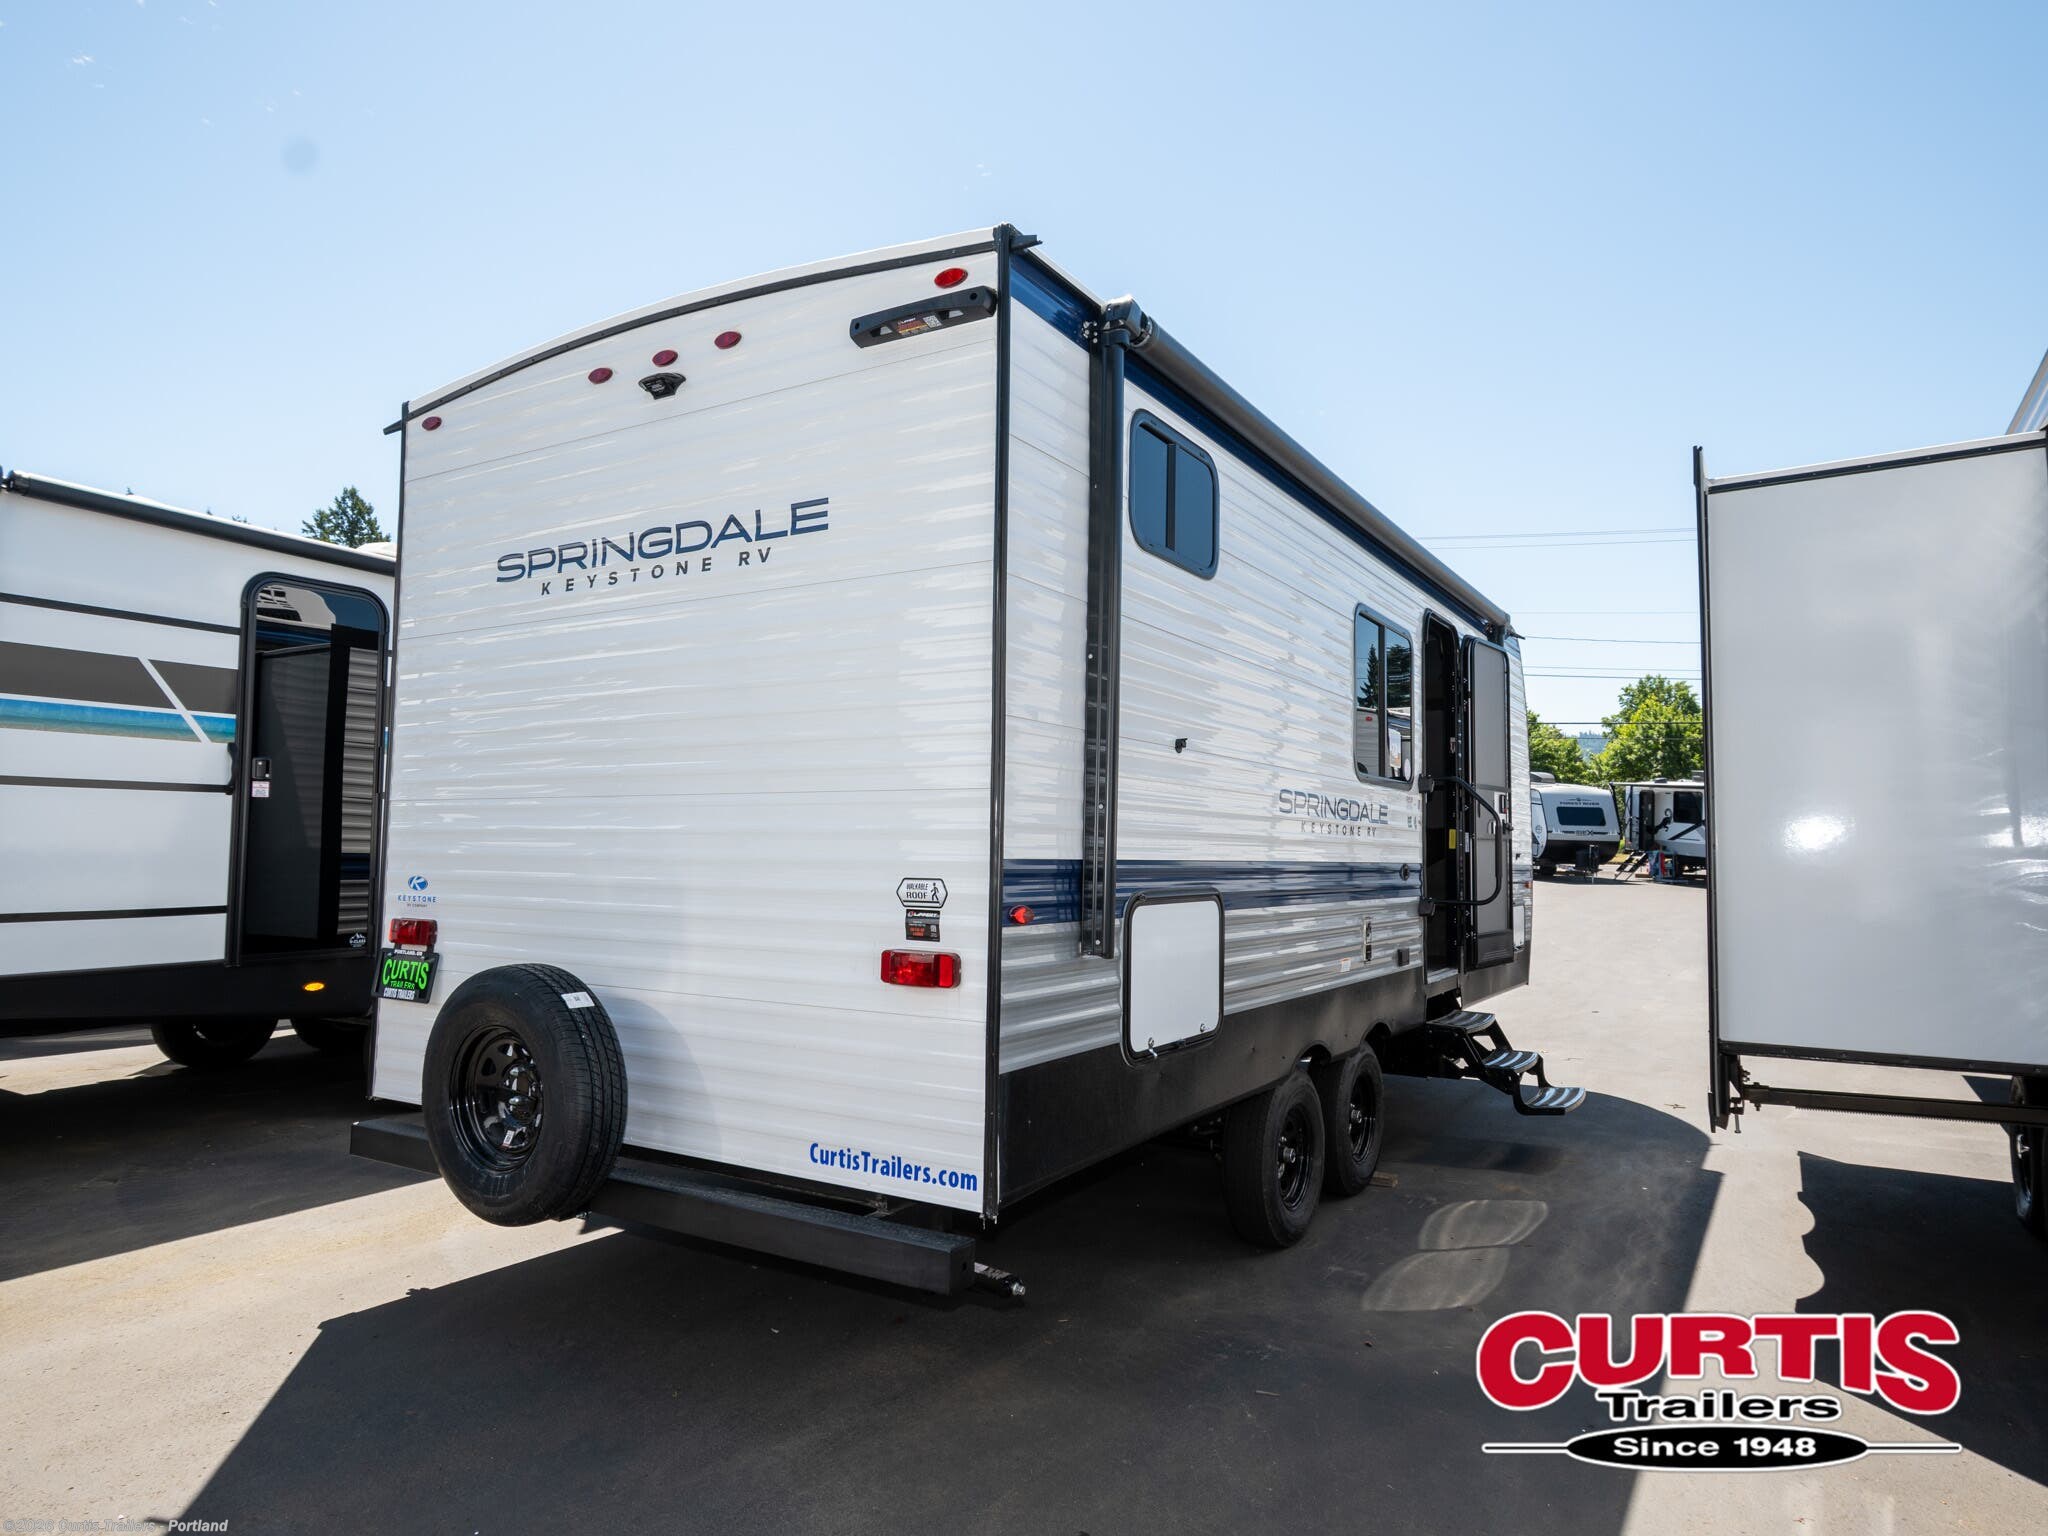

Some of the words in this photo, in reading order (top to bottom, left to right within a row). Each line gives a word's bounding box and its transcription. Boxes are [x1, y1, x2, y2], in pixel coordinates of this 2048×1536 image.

[496, 497, 829, 583] SPRINGDALE
[541, 556, 713, 596] KEYSTONE
[737, 546, 772, 567] RV
[1279, 788, 1389, 824] SPRINGDALE
[1301, 820, 1361, 837] KEYSTONE
[1367, 826, 1377, 838] RV
[397, 894, 437, 903] KEYSTONE
[906, 882, 929, 891] WALKABLE
[906, 891, 928, 899] ROOF
[382, 958, 429, 990] CURTIS
[809, 1142, 978, 1192] CurtisTrailers.com
